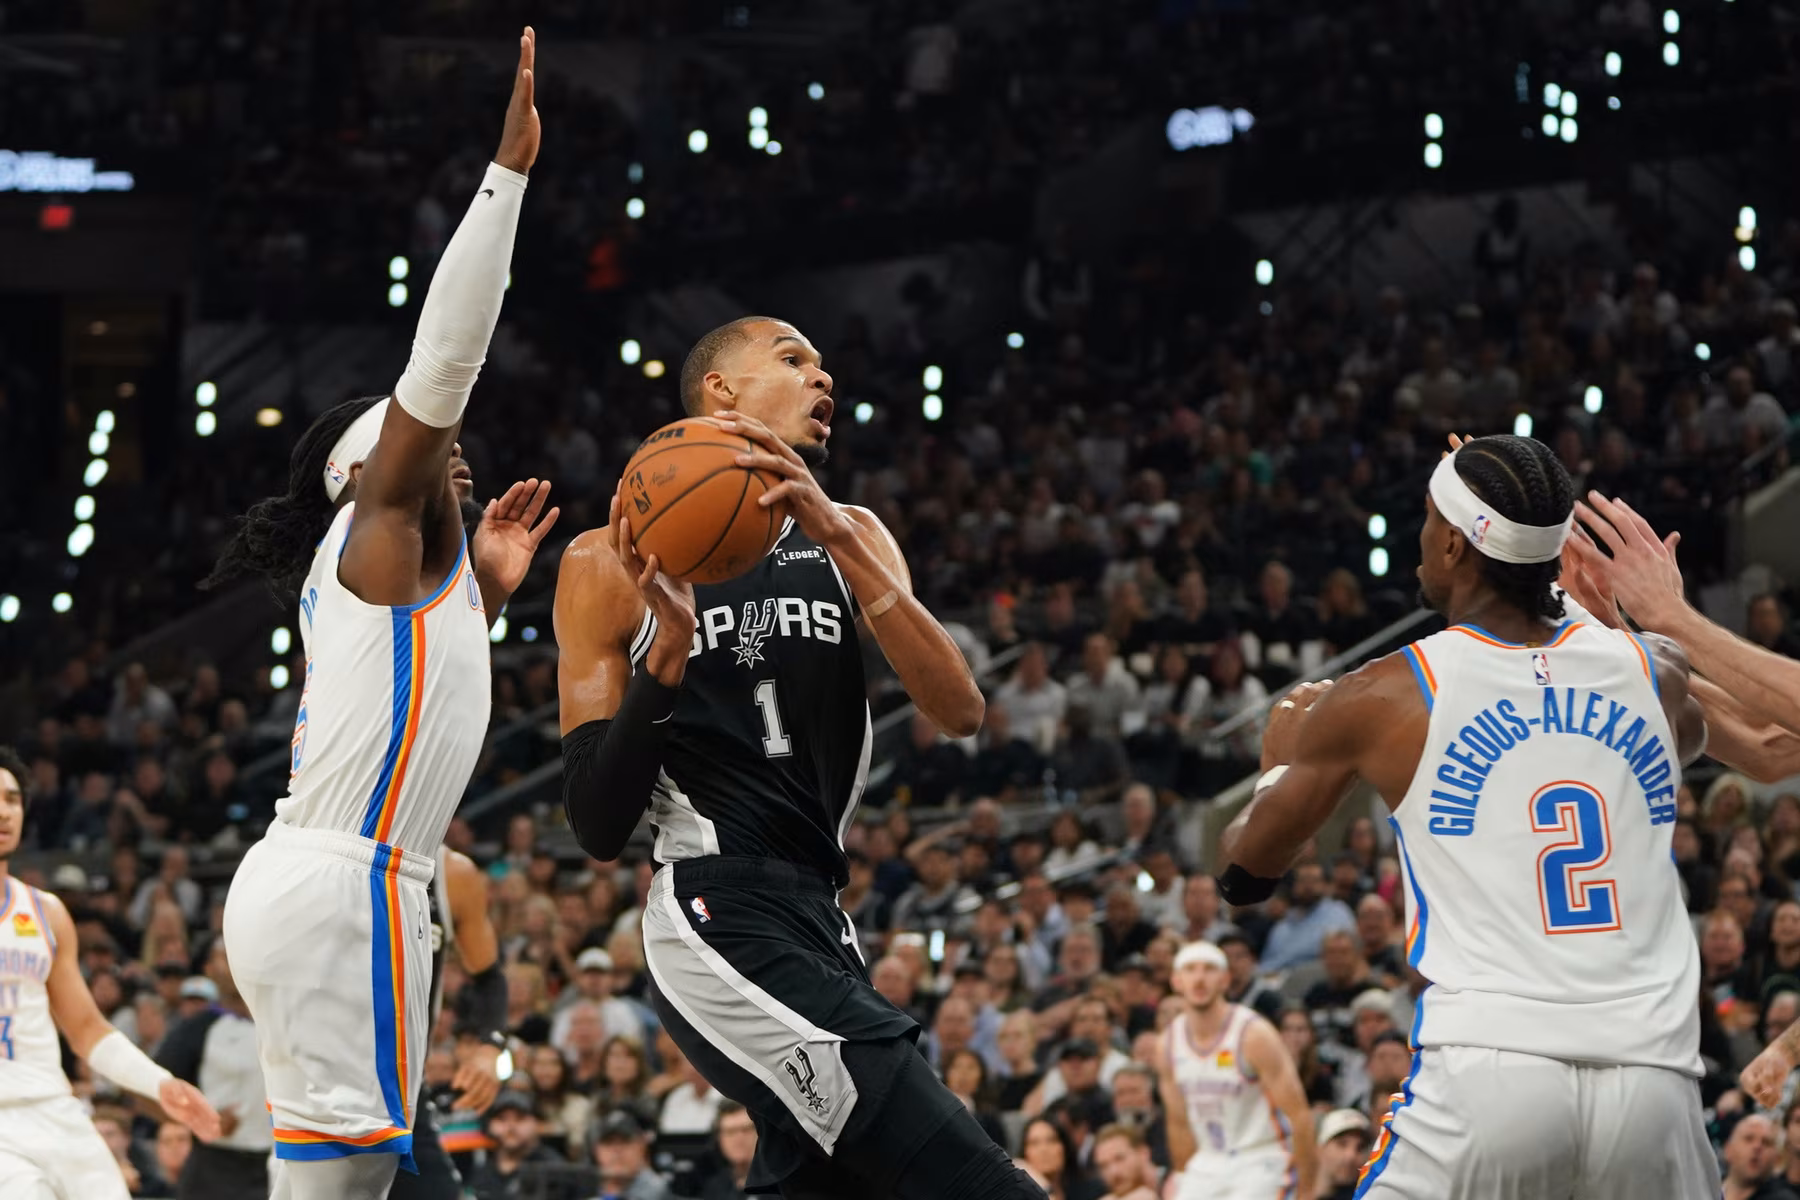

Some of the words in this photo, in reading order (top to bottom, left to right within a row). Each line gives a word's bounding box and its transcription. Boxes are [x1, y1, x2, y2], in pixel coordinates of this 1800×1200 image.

[782, 550, 820, 560] LEDGER
[754, 679, 793, 758] 1
[1429, 687, 1677, 836] GILGEOUS-ALEXANDER
[1529, 780, 1622, 935] 2
